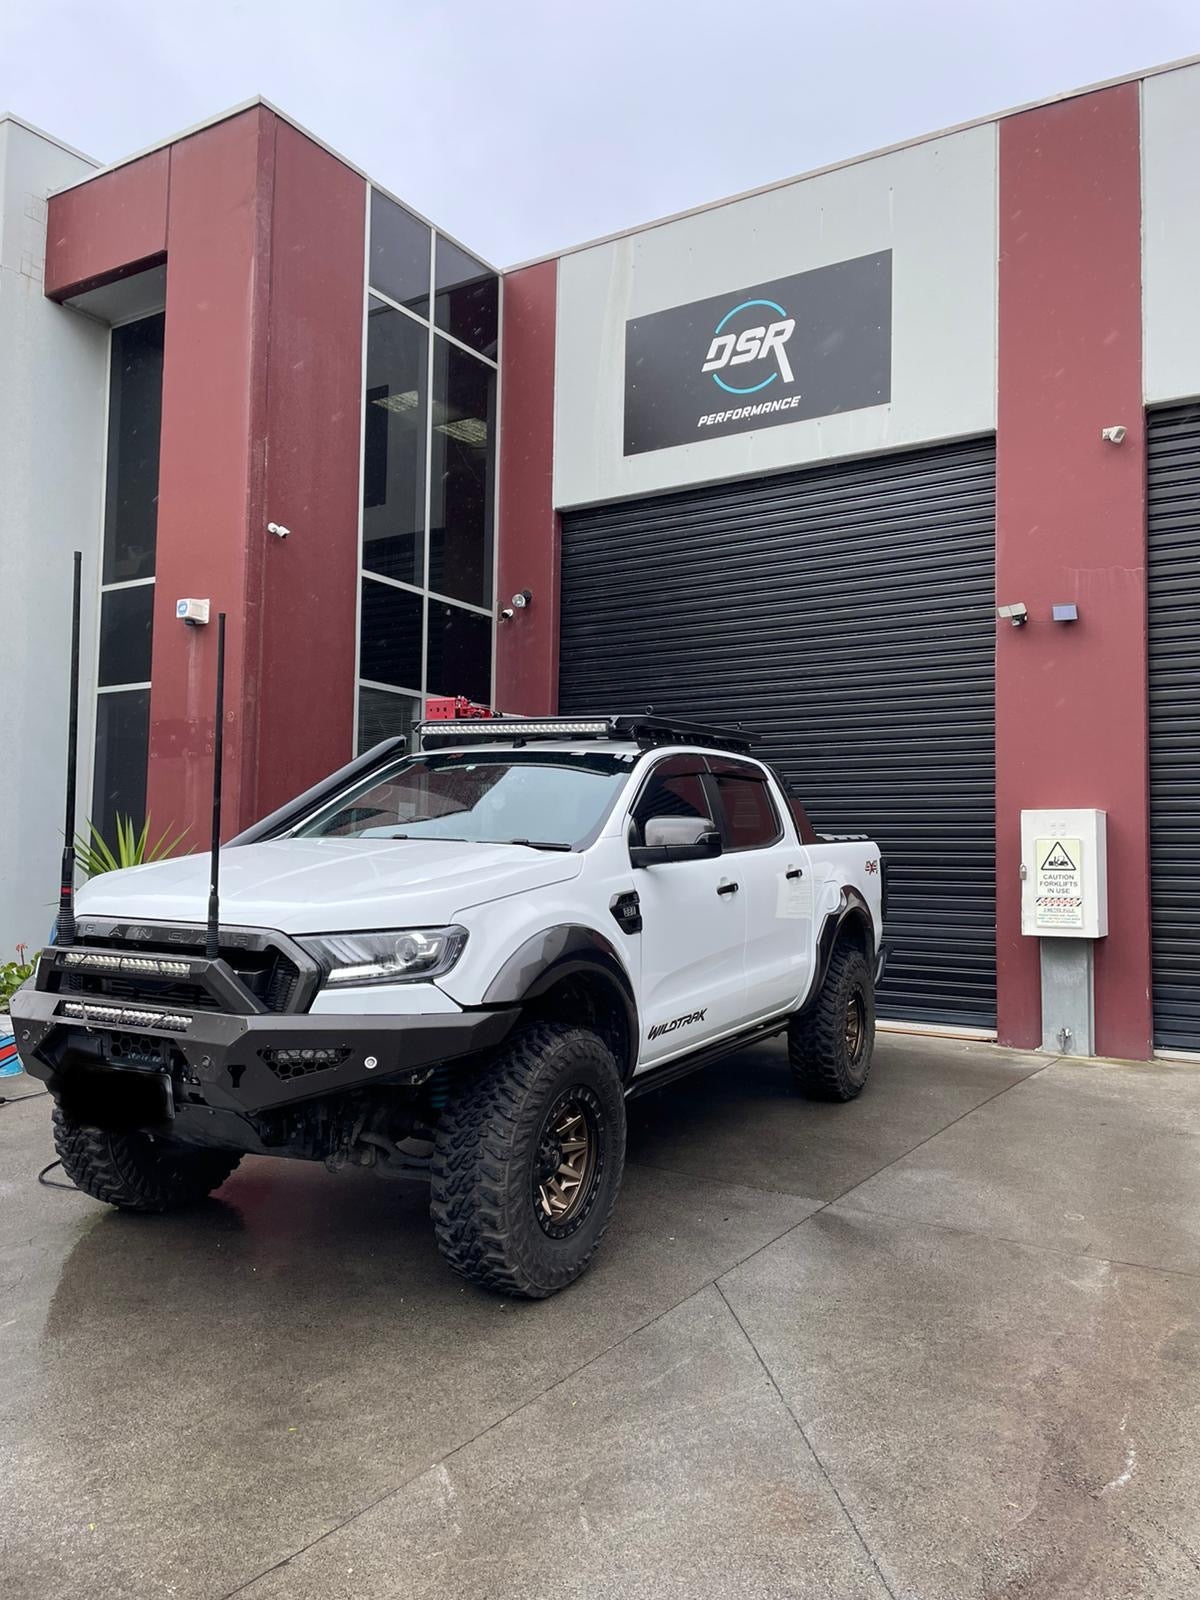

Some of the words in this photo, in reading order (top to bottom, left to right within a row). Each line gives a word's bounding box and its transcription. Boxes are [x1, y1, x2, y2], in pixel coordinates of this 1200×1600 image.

[701, 319, 796, 383] DSR
[697, 395, 801, 427] PERFORMANCE
[648, 1008, 708, 1041] WILDTRAK
